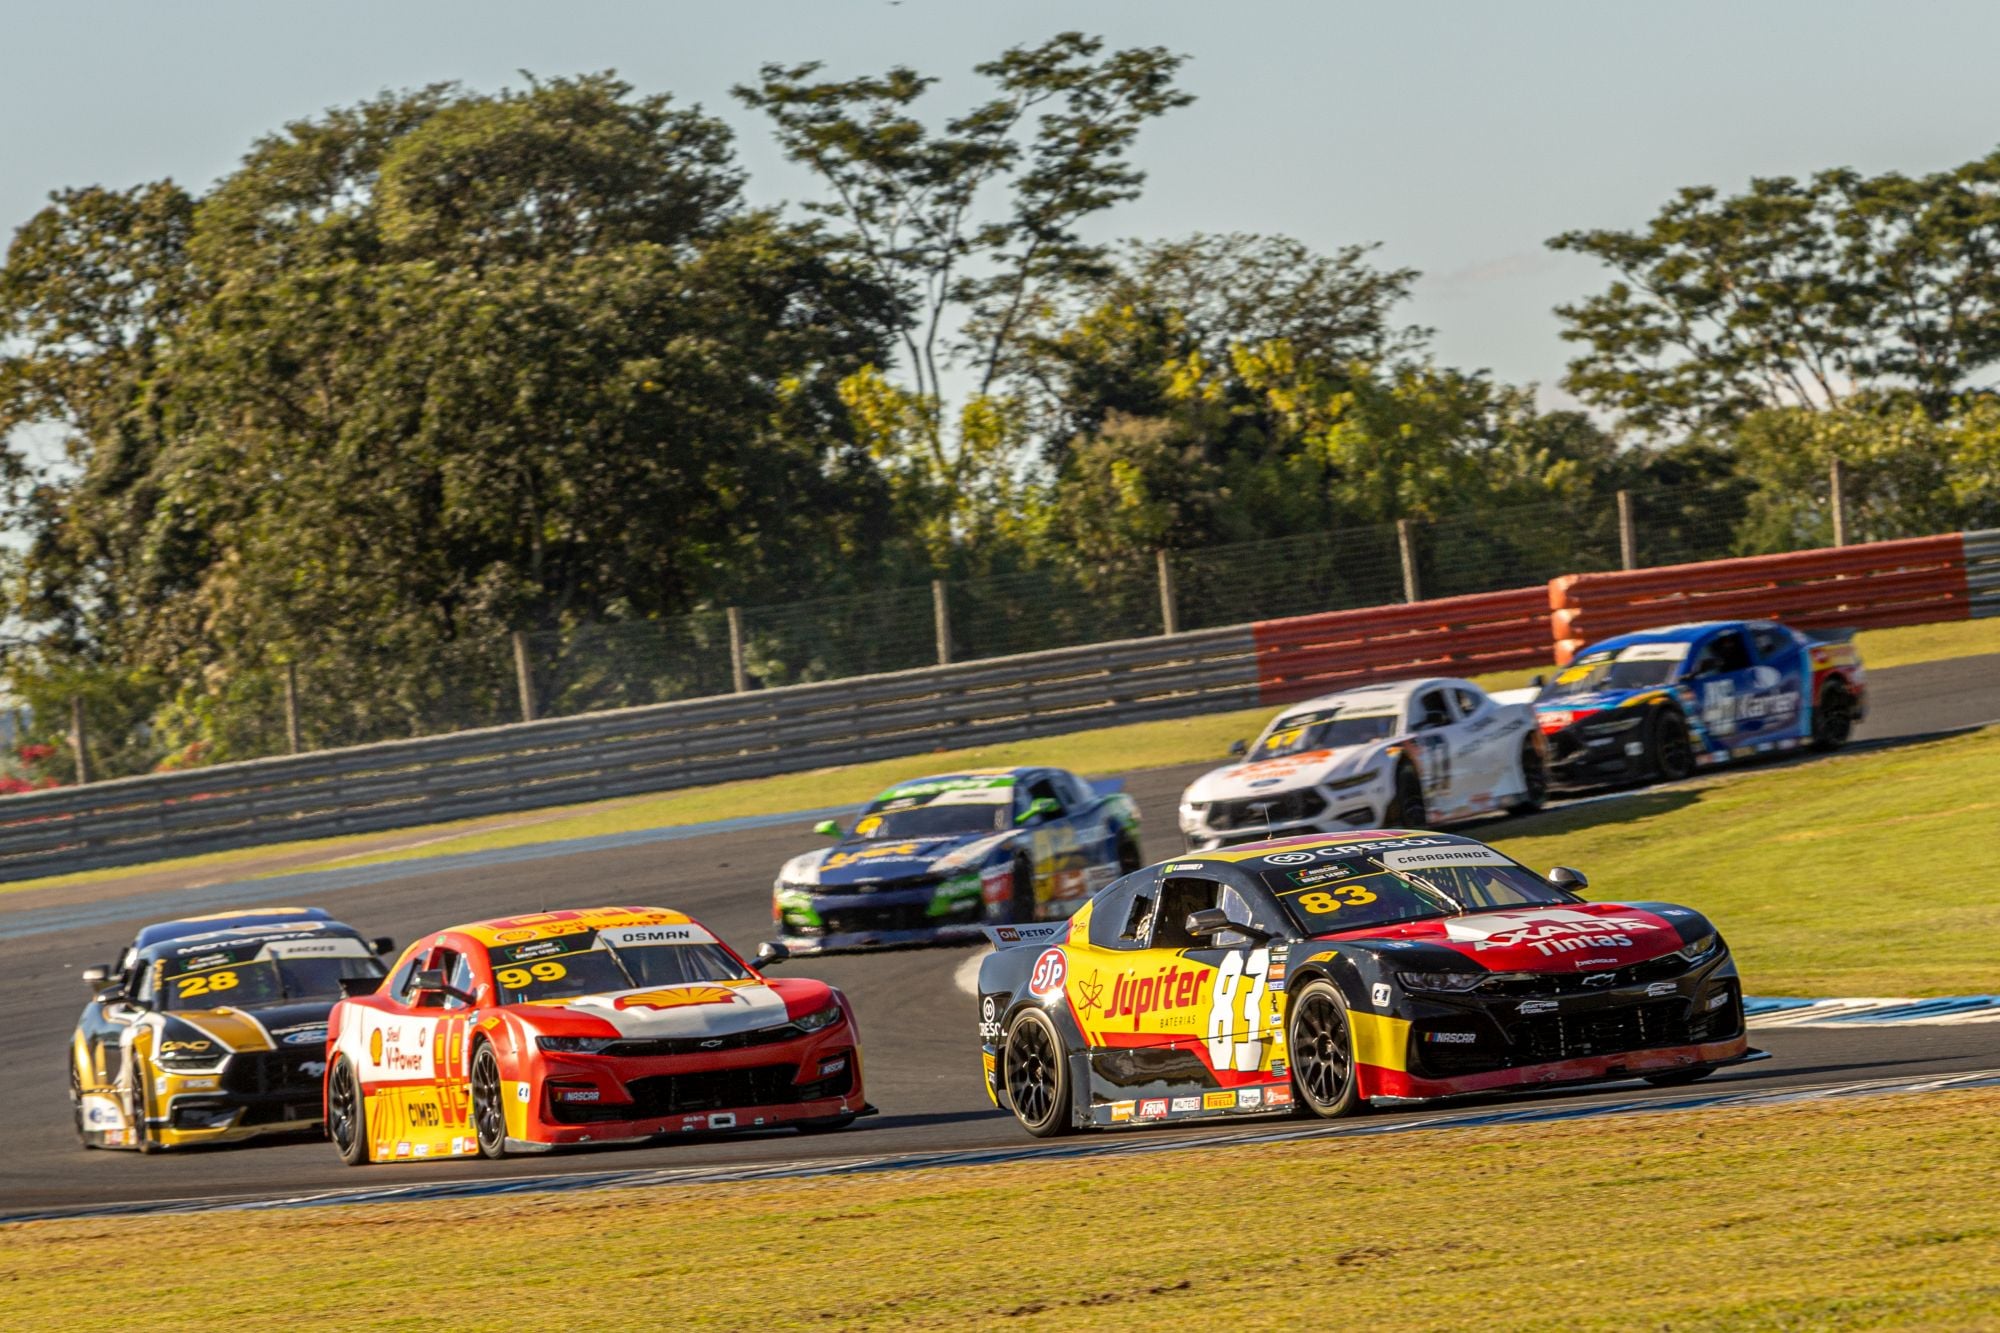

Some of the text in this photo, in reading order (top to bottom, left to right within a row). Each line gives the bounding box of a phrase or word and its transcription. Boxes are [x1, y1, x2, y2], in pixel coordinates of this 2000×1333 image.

[1316, 837, 1451, 857] CRESOL
[1398, 851, 1492, 864] CASAGRANDE
[1298, 885, 1378, 914] 83
[623, 930, 690, 943] OSMAN
[1000, 928, 1055, 939] ON PETRO
[1475, 920, 1660, 951] AXALTA
[1528, 932, 1634, 956] Tintas
[496, 962, 567, 989] 99
[1033, 954, 1063, 989] STP
[177, 971, 240, 999] 28
[1160, 1015, 1197, 1028] BATERIAS
[1208, 948, 1269, 1072] 83
[1435, 1033, 1477, 1043] NASCAR
[386, 1047, 422, 1070] V-Power
[566, 1091, 600, 1101] NASCAR
[408, 1102, 440, 1127] CIMED
